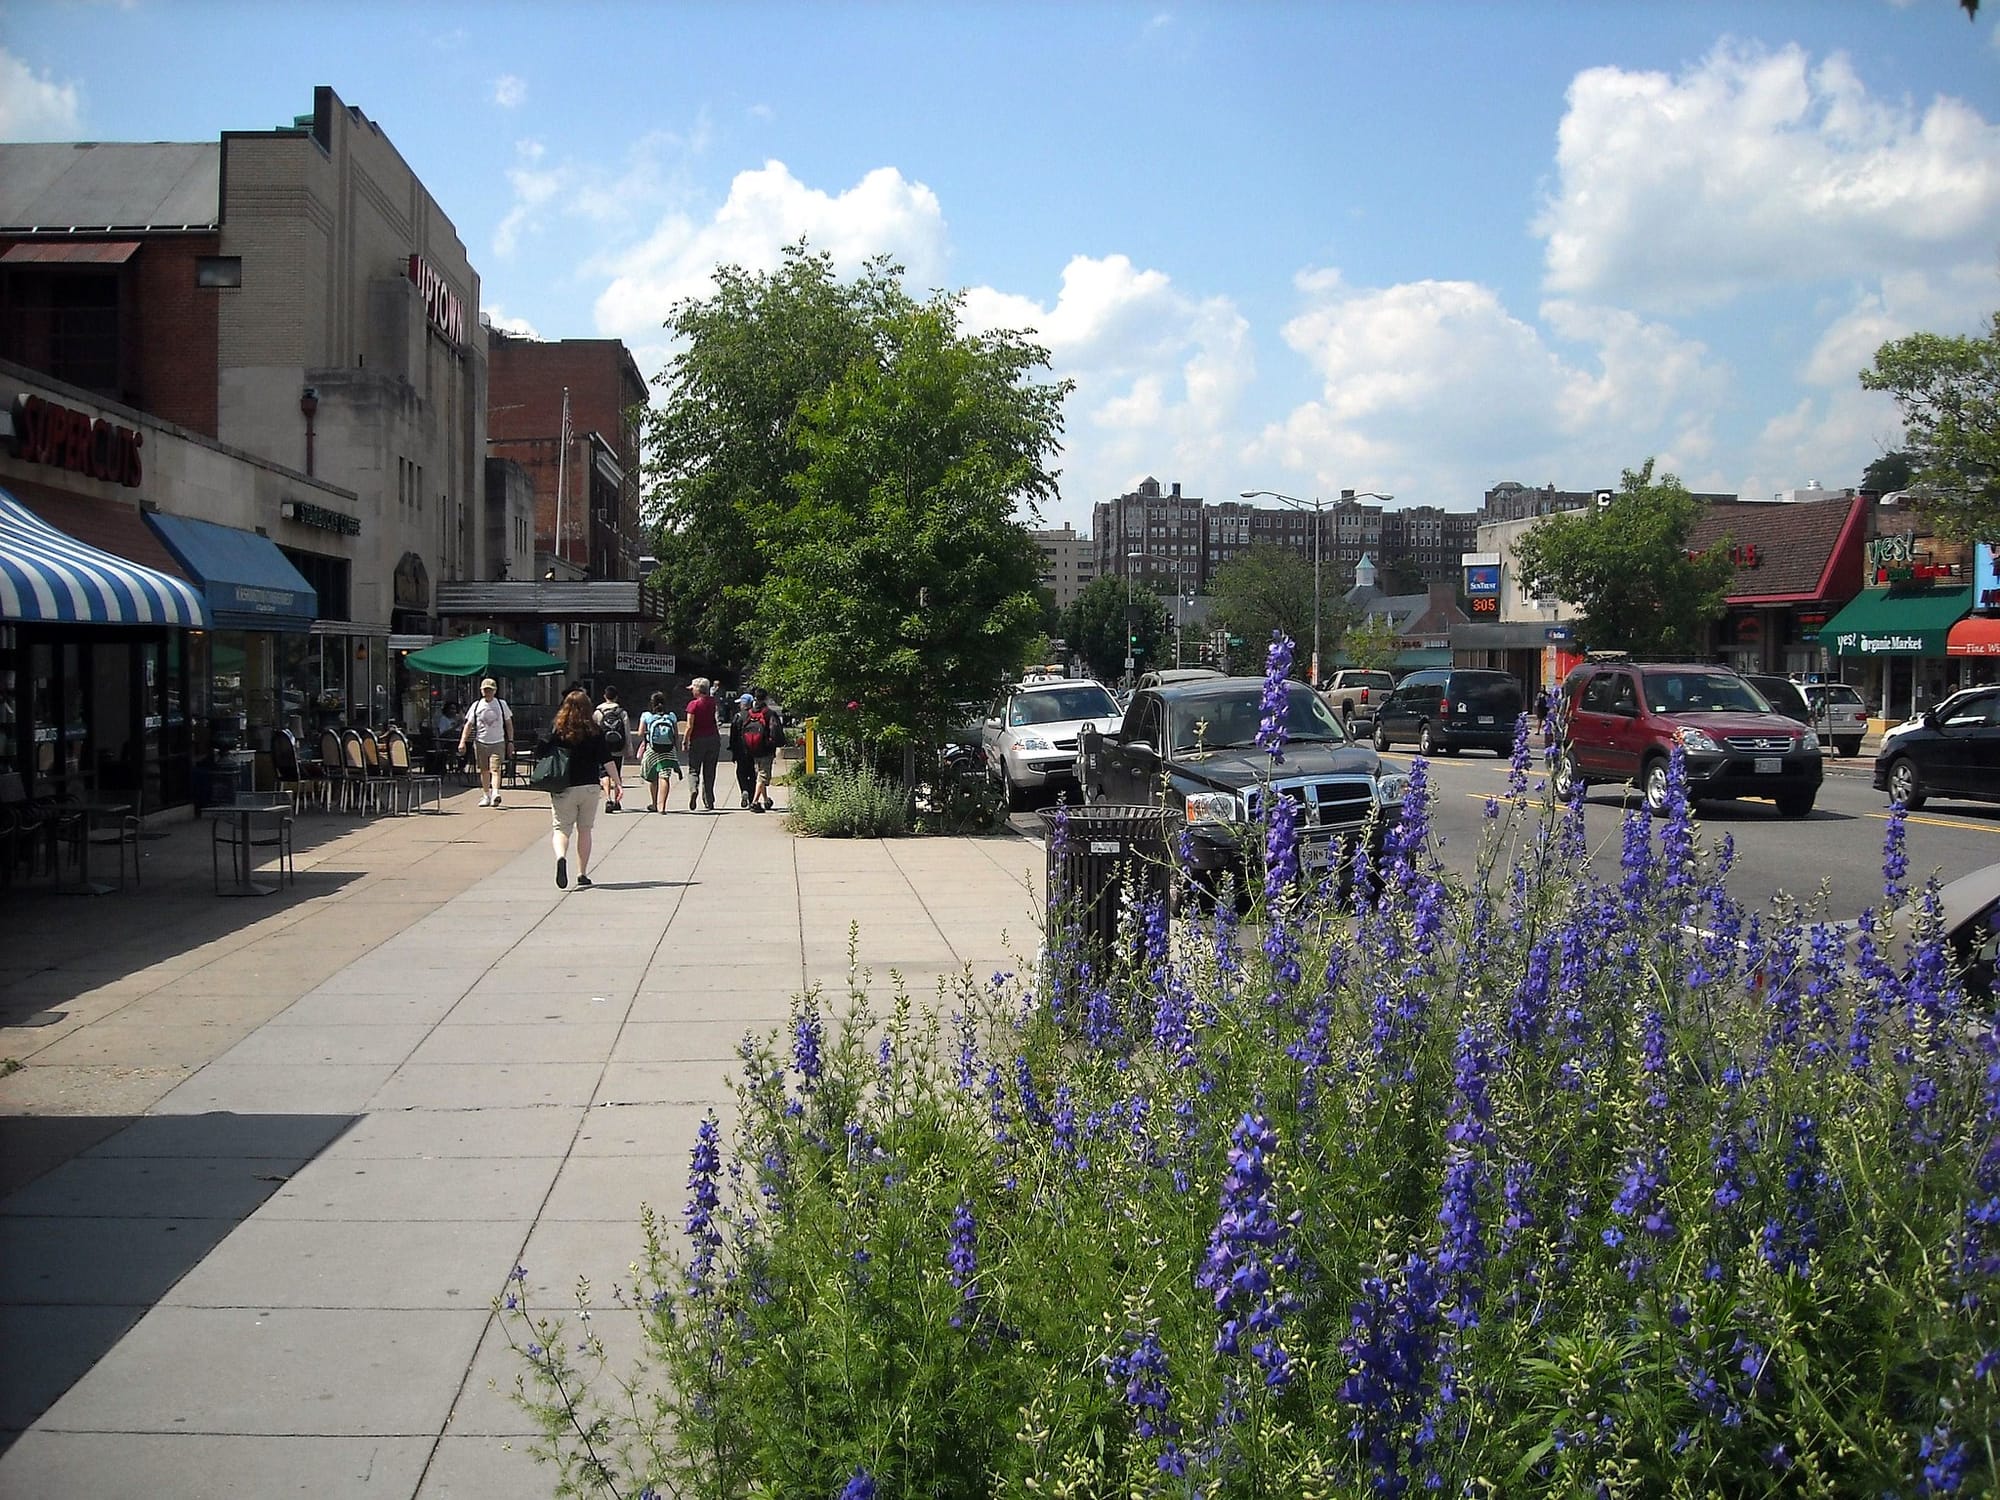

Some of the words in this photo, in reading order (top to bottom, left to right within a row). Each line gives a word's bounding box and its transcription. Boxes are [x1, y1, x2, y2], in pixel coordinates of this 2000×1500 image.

[416, 255, 463, 344] UPTOWN
[16, 394, 143, 487] SUPERCUTS
[1866, 528, 1914, 585] yes!
[1837, 633, 1857, 655] yes!
[1860, 634, 1891, 654] Organic
[1891, 636, 1922, 650] Market
[1966, 643, 1985, 653] Fine
